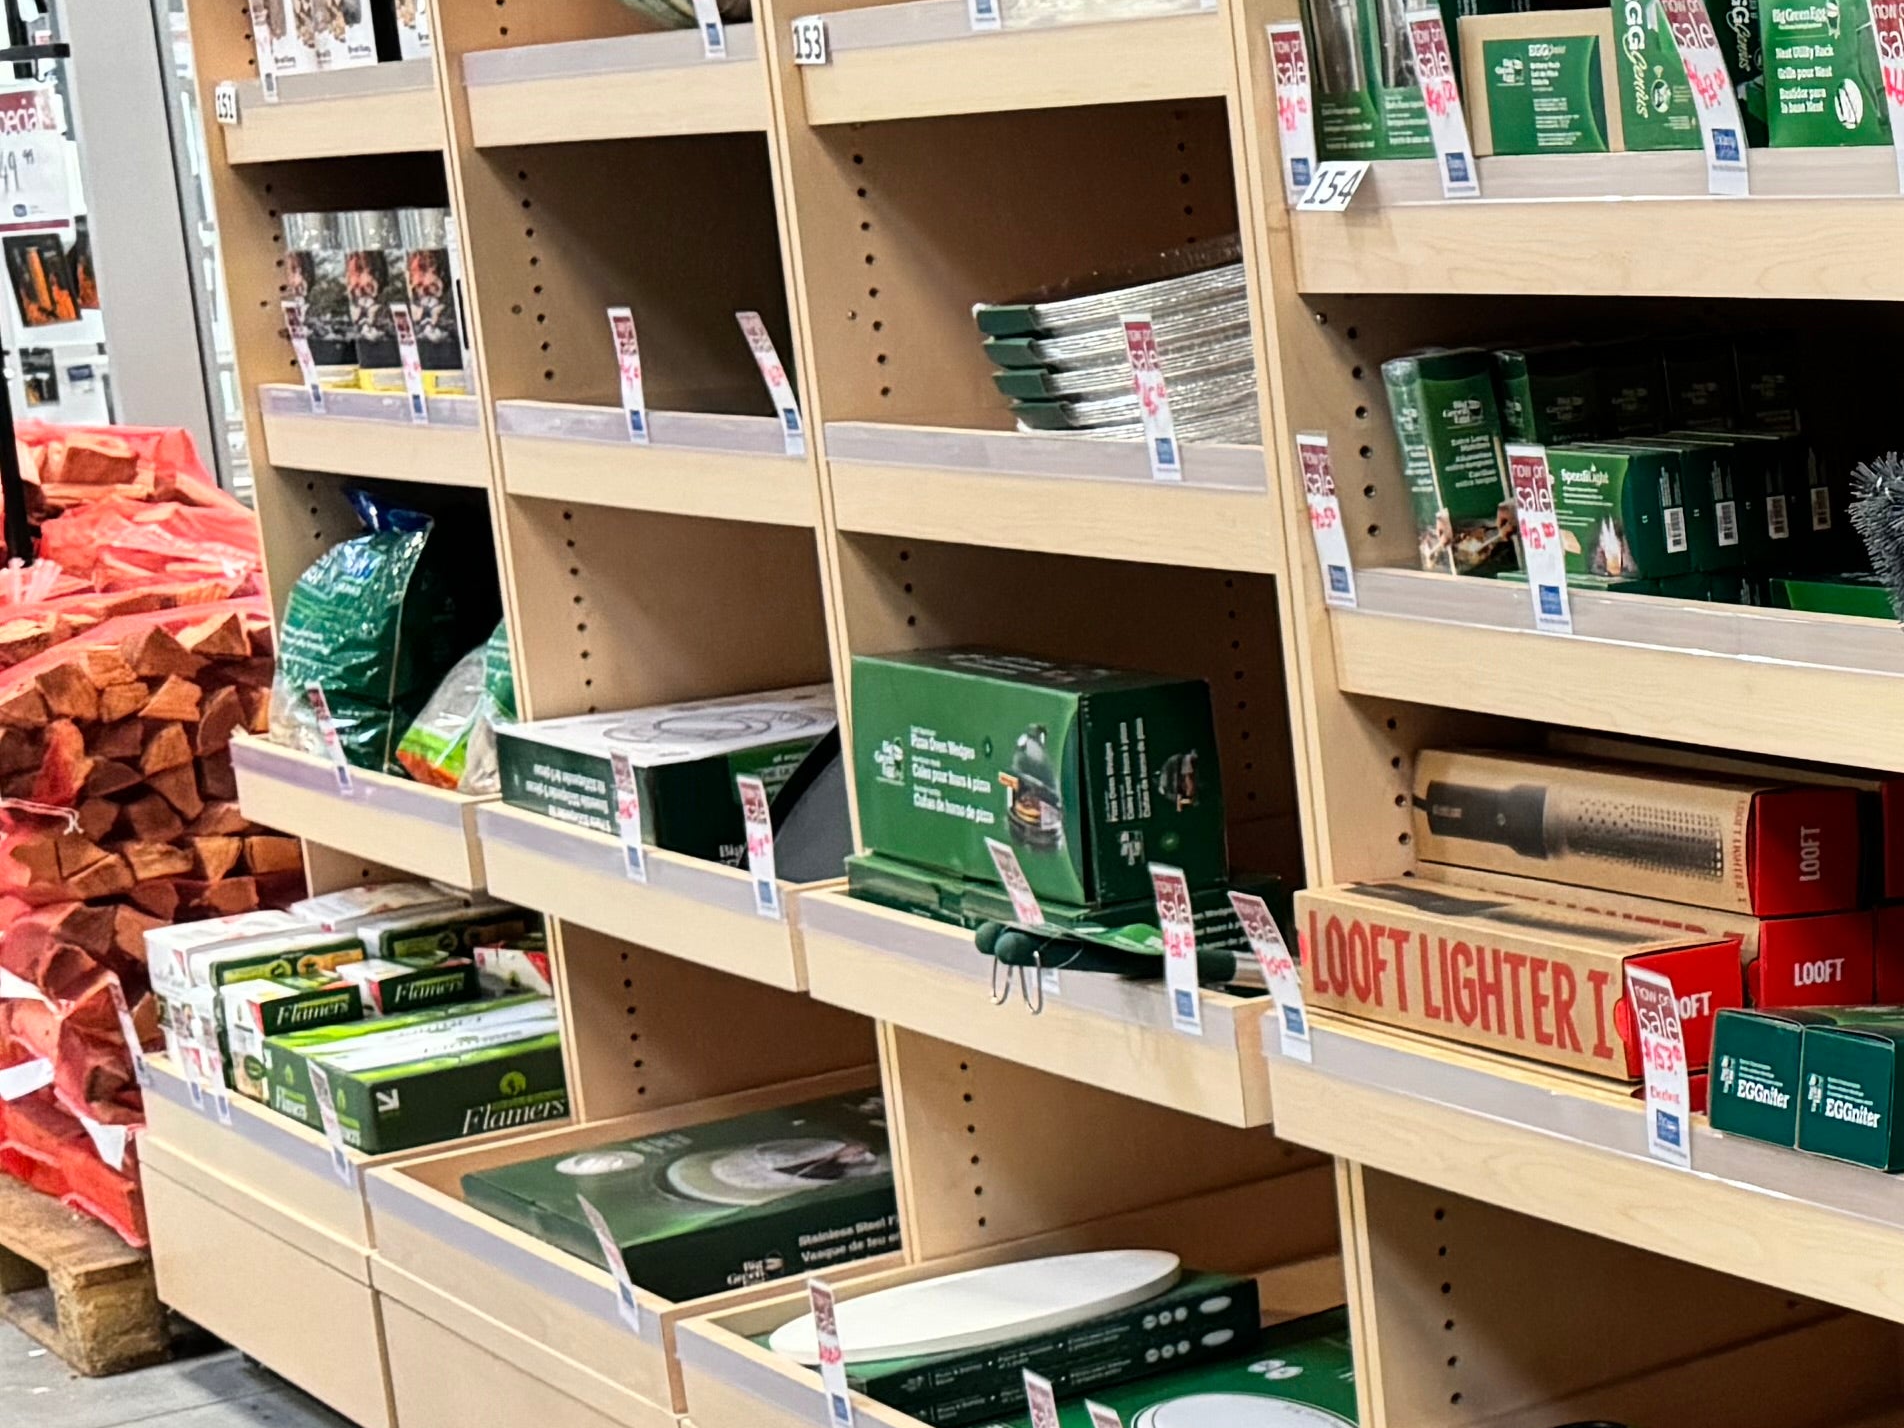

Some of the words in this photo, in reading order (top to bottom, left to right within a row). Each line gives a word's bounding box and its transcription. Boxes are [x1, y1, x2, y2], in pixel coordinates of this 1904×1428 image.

[793, 24, 823, 61] 153
[1672, 13, 1714, 50] sale
[215, 85, 234, 120] 151
[1301, 169, 1360, 207] 154
[1799, 826, 1821, 882] LOOFT
[395, 973, 465, 1004] Flamers
[1308, 910, 1411, 1013] LOOFT
[1419, 933, 1584, 1054] LIGHTER
[1587, 969, 1615, 1060] I
[1794, 958, 1846, 987] LOOFT
[277, 998, 350, 1026] Flamers
[1639, 1008, 1680, 1041] sale
[1737, 1079, 1790, 1110] EGGniter
[462, 1097, 566, 1136] Flamers
[1824, 1097, 1881, 1129] EGGniter
